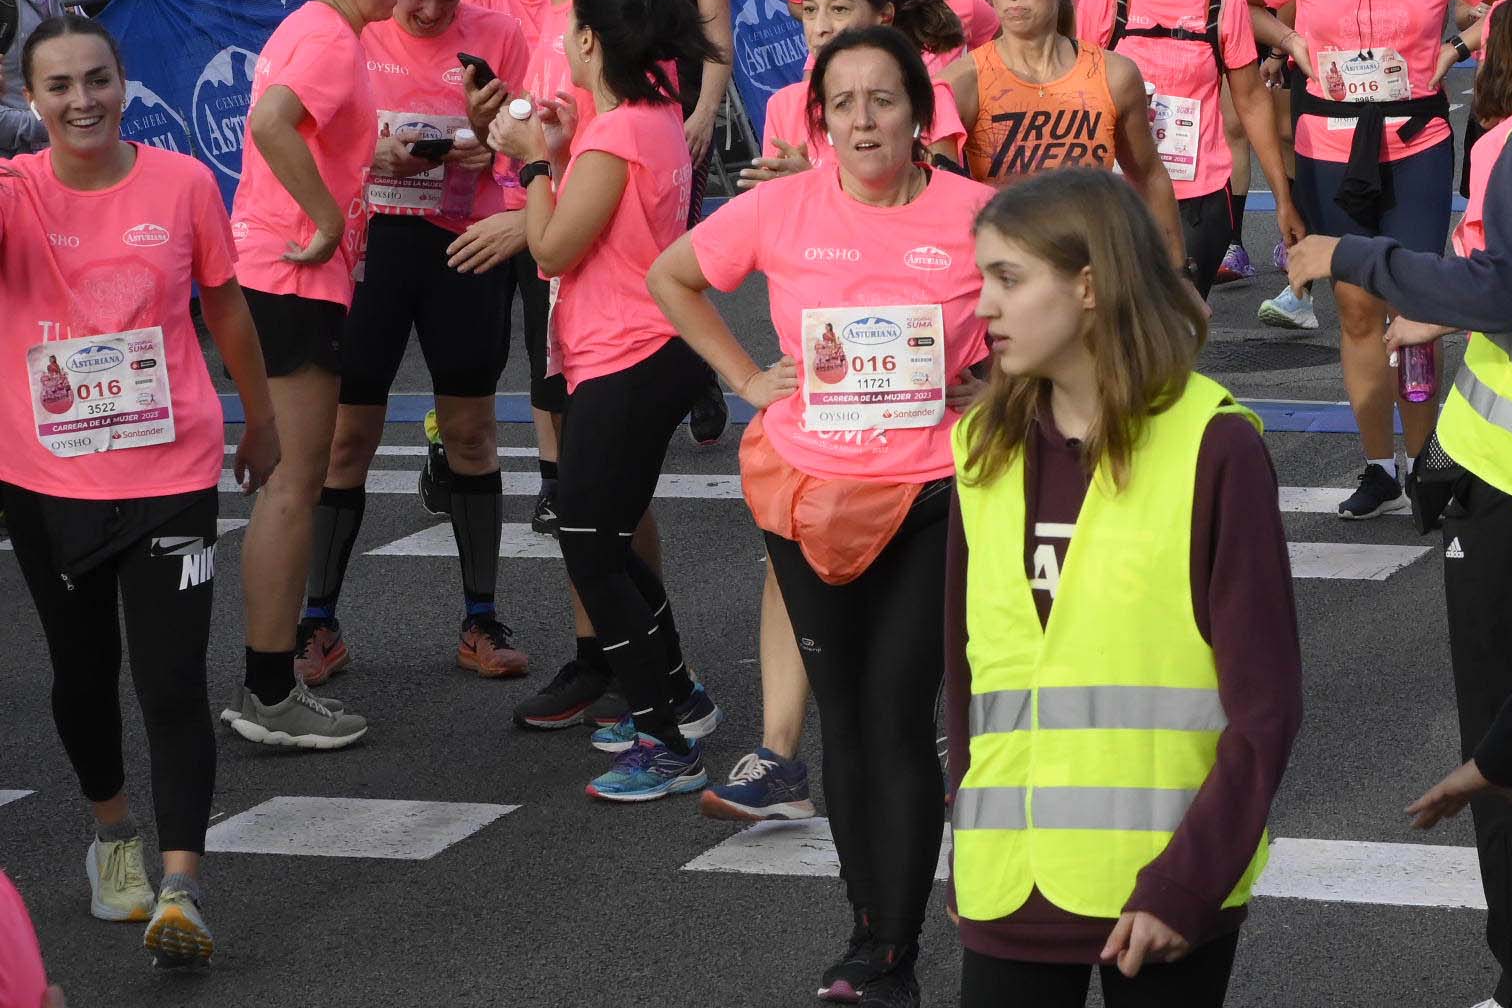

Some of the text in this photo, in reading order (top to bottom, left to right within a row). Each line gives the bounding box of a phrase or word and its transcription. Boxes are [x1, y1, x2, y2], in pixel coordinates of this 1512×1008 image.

[743, 34, 810, 76] ASTURIAN
[1348, 80, 1379, 94] 016
[215, 93, 253, 111] CENTRA
[987, 109, 1103, 178] 7 RUN
[1004, 142, 1109, 177] NERS
[804, 247, 861, 263] OYSHO
[906, 320, 934, 330] SUMA
[848, 327, 898, 340] ASTURIANA
[128, 343, 154, 354] SUMA
[70, 354, 121, 370] ASTURIANA
[851, 354, 897, 373] 016
[76, 378, 123, 401] 016
[857, 377, 892, 390] 11721
[822, 391, 932, 404] CARRERA DE LA MUJER 2023
[87, 401, 117, 415] 3522
[819, 407, 937, 423] OYSHO Santander
[52, 420, 89, 433] CARRERA
[89, 419, 102, 428] DE
[101, 417, 112, 425] LA
[111, 413, 139, 424] MUJER
[51, 425, 165, 450] OYSHO Santander
[179, 545, 216, 591] NIK
